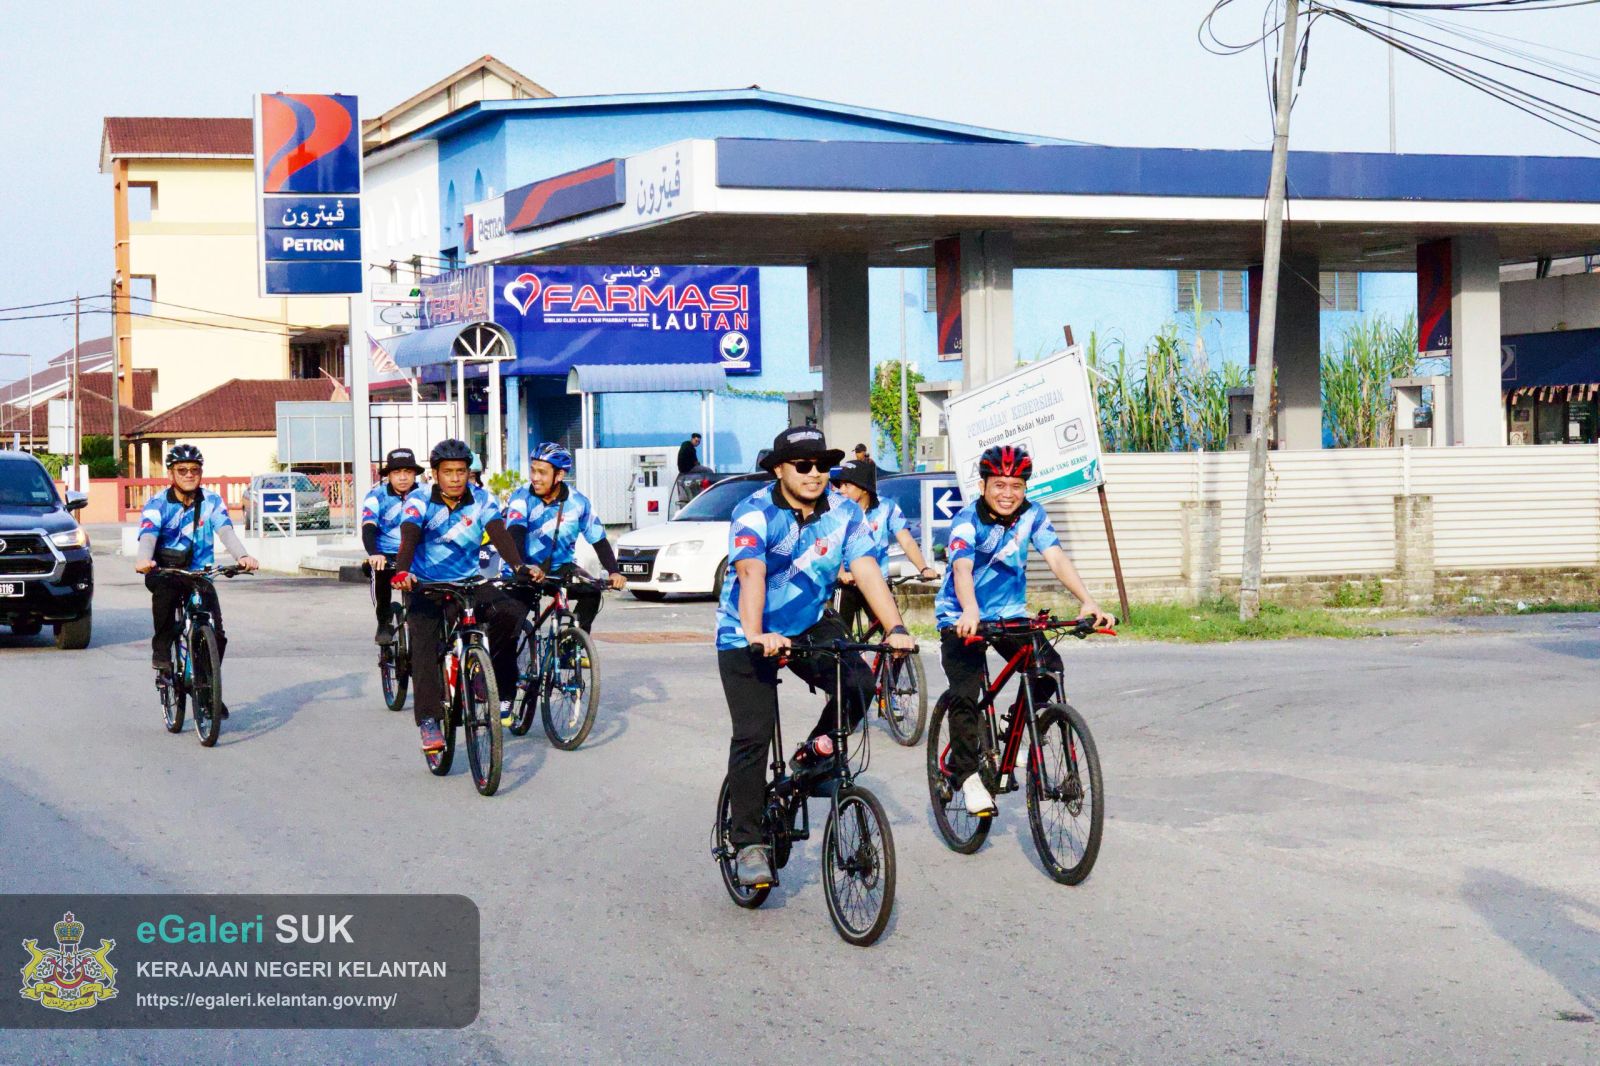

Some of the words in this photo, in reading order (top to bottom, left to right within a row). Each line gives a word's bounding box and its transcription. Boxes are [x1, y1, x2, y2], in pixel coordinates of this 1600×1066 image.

[282, 200, 345, 227] ڤيترون
[282, 236, 345, 252] PETRON
[603, 265, 661, 283] فرماسي
[542, 284, 749, 312] FARMASI
[651, 312, 749, 331] LAUTAN
[1004, 427, 1017, 439] Dan
[1063, 423, 1079, 443] C
